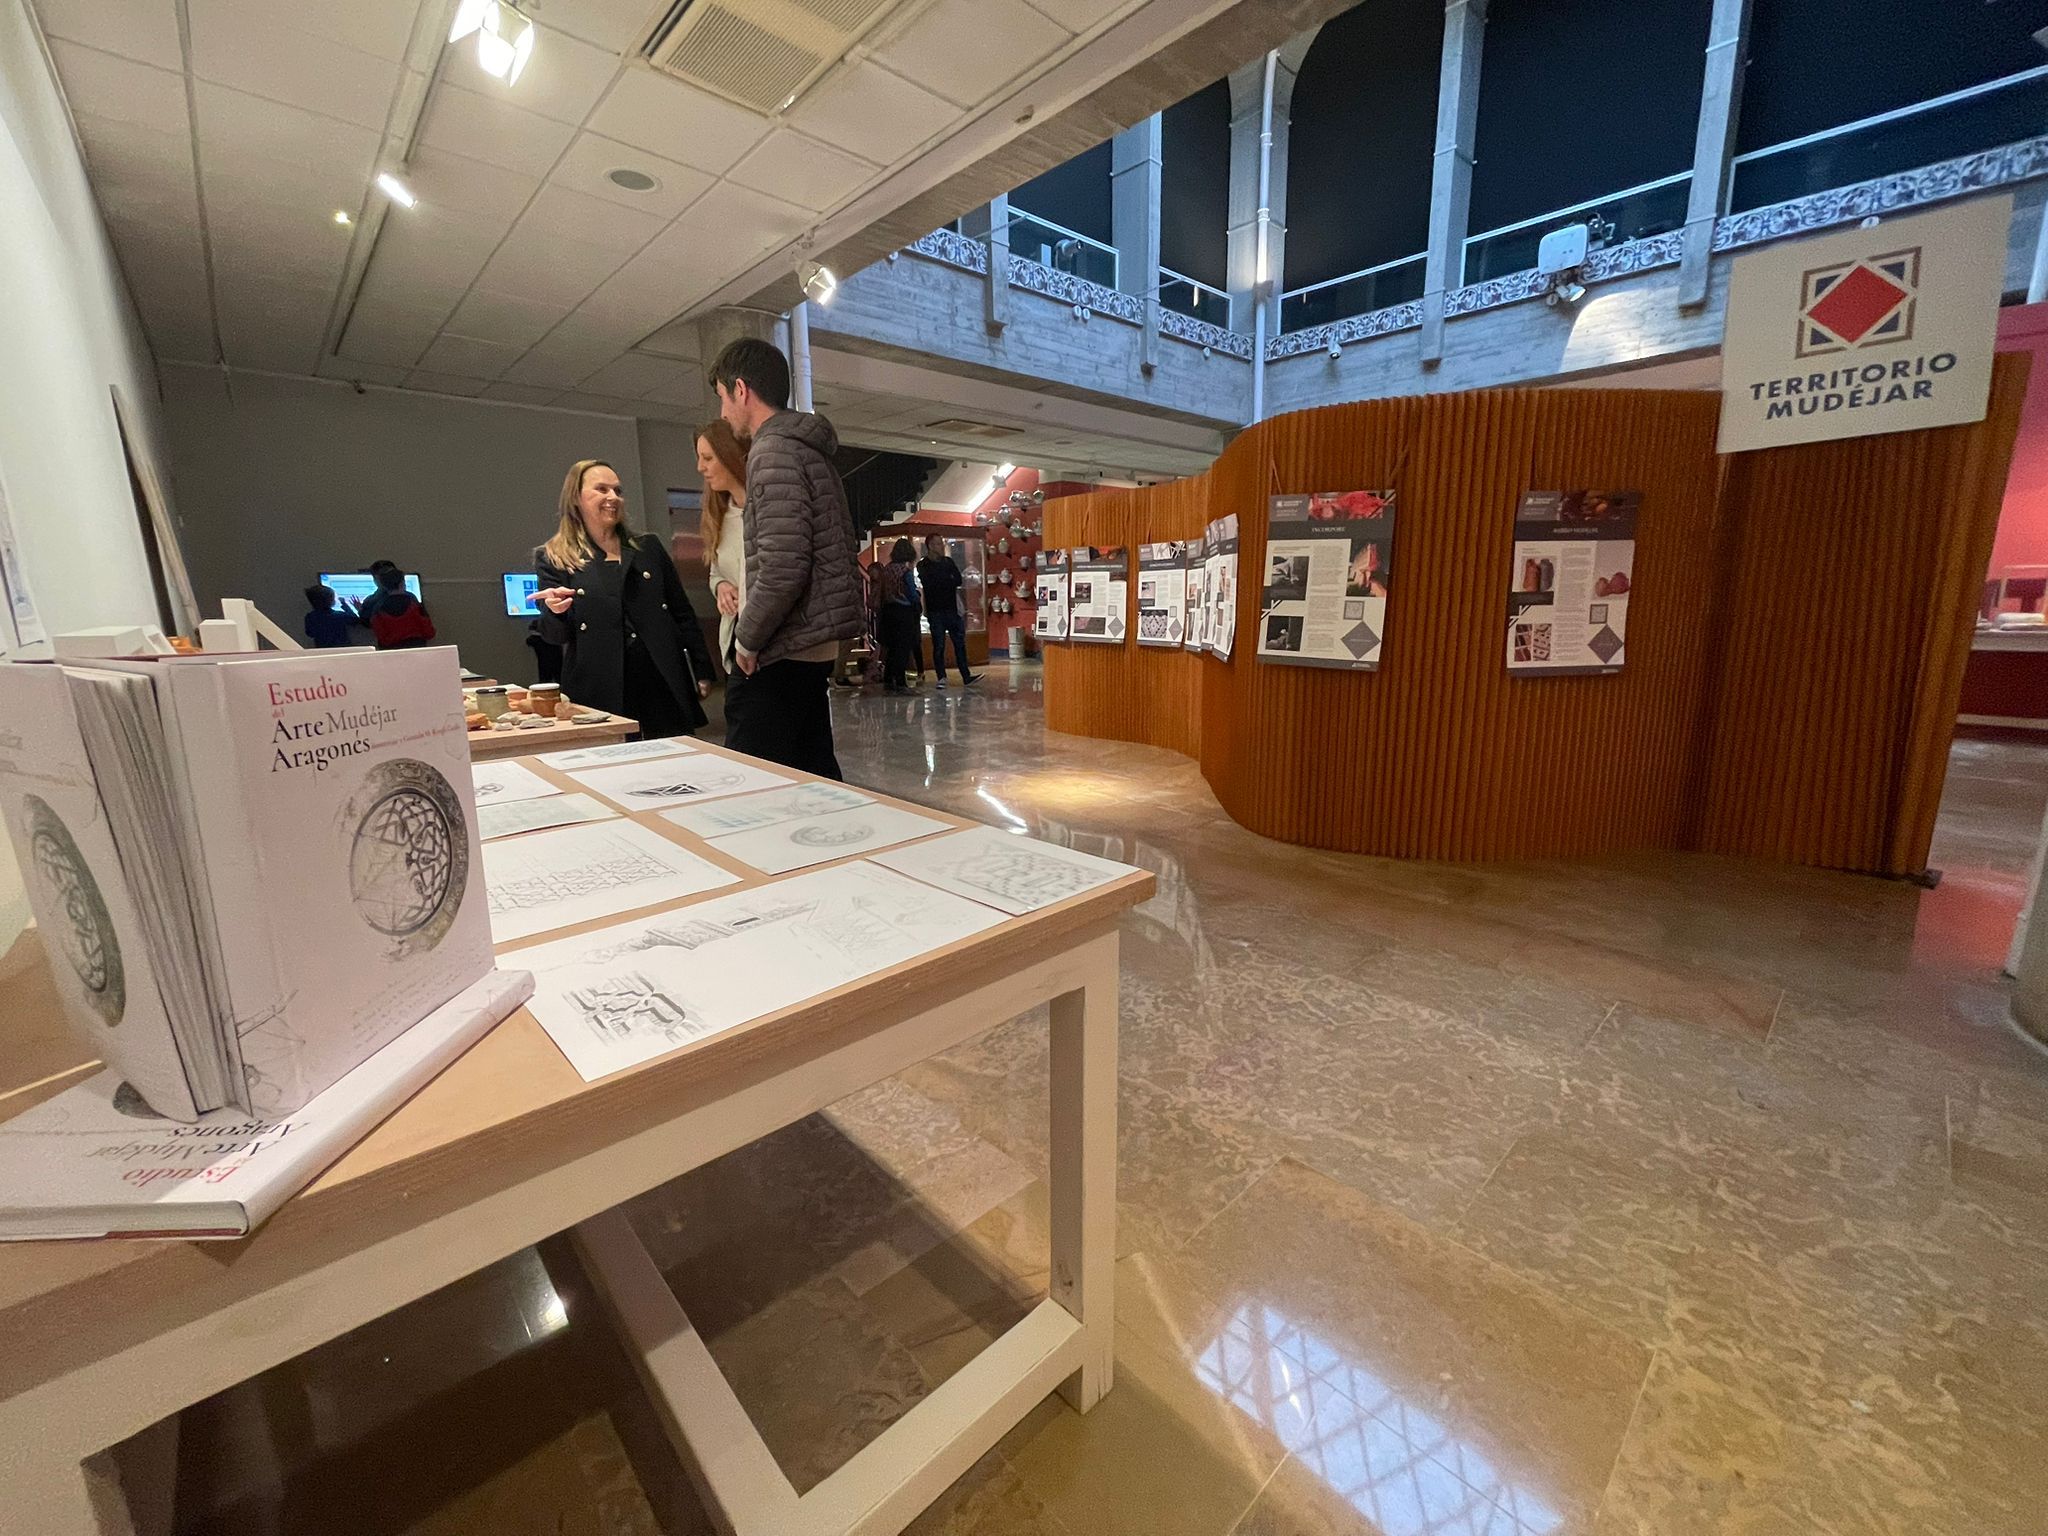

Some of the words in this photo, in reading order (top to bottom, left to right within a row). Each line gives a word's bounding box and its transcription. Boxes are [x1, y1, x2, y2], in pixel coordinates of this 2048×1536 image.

[1750, 353, 1957, 400] TERRITORIO
[1766, 380, 1933, 420] MUDÉJAR
[268, 676, 347, 706] Estudio
[272, 719, 324, 744] Arte
[325, 705, 397, 733] Mudéjar
[271, 730, 371, 772] Aragonés
[122, 1167, 239, 1188] Estudio
